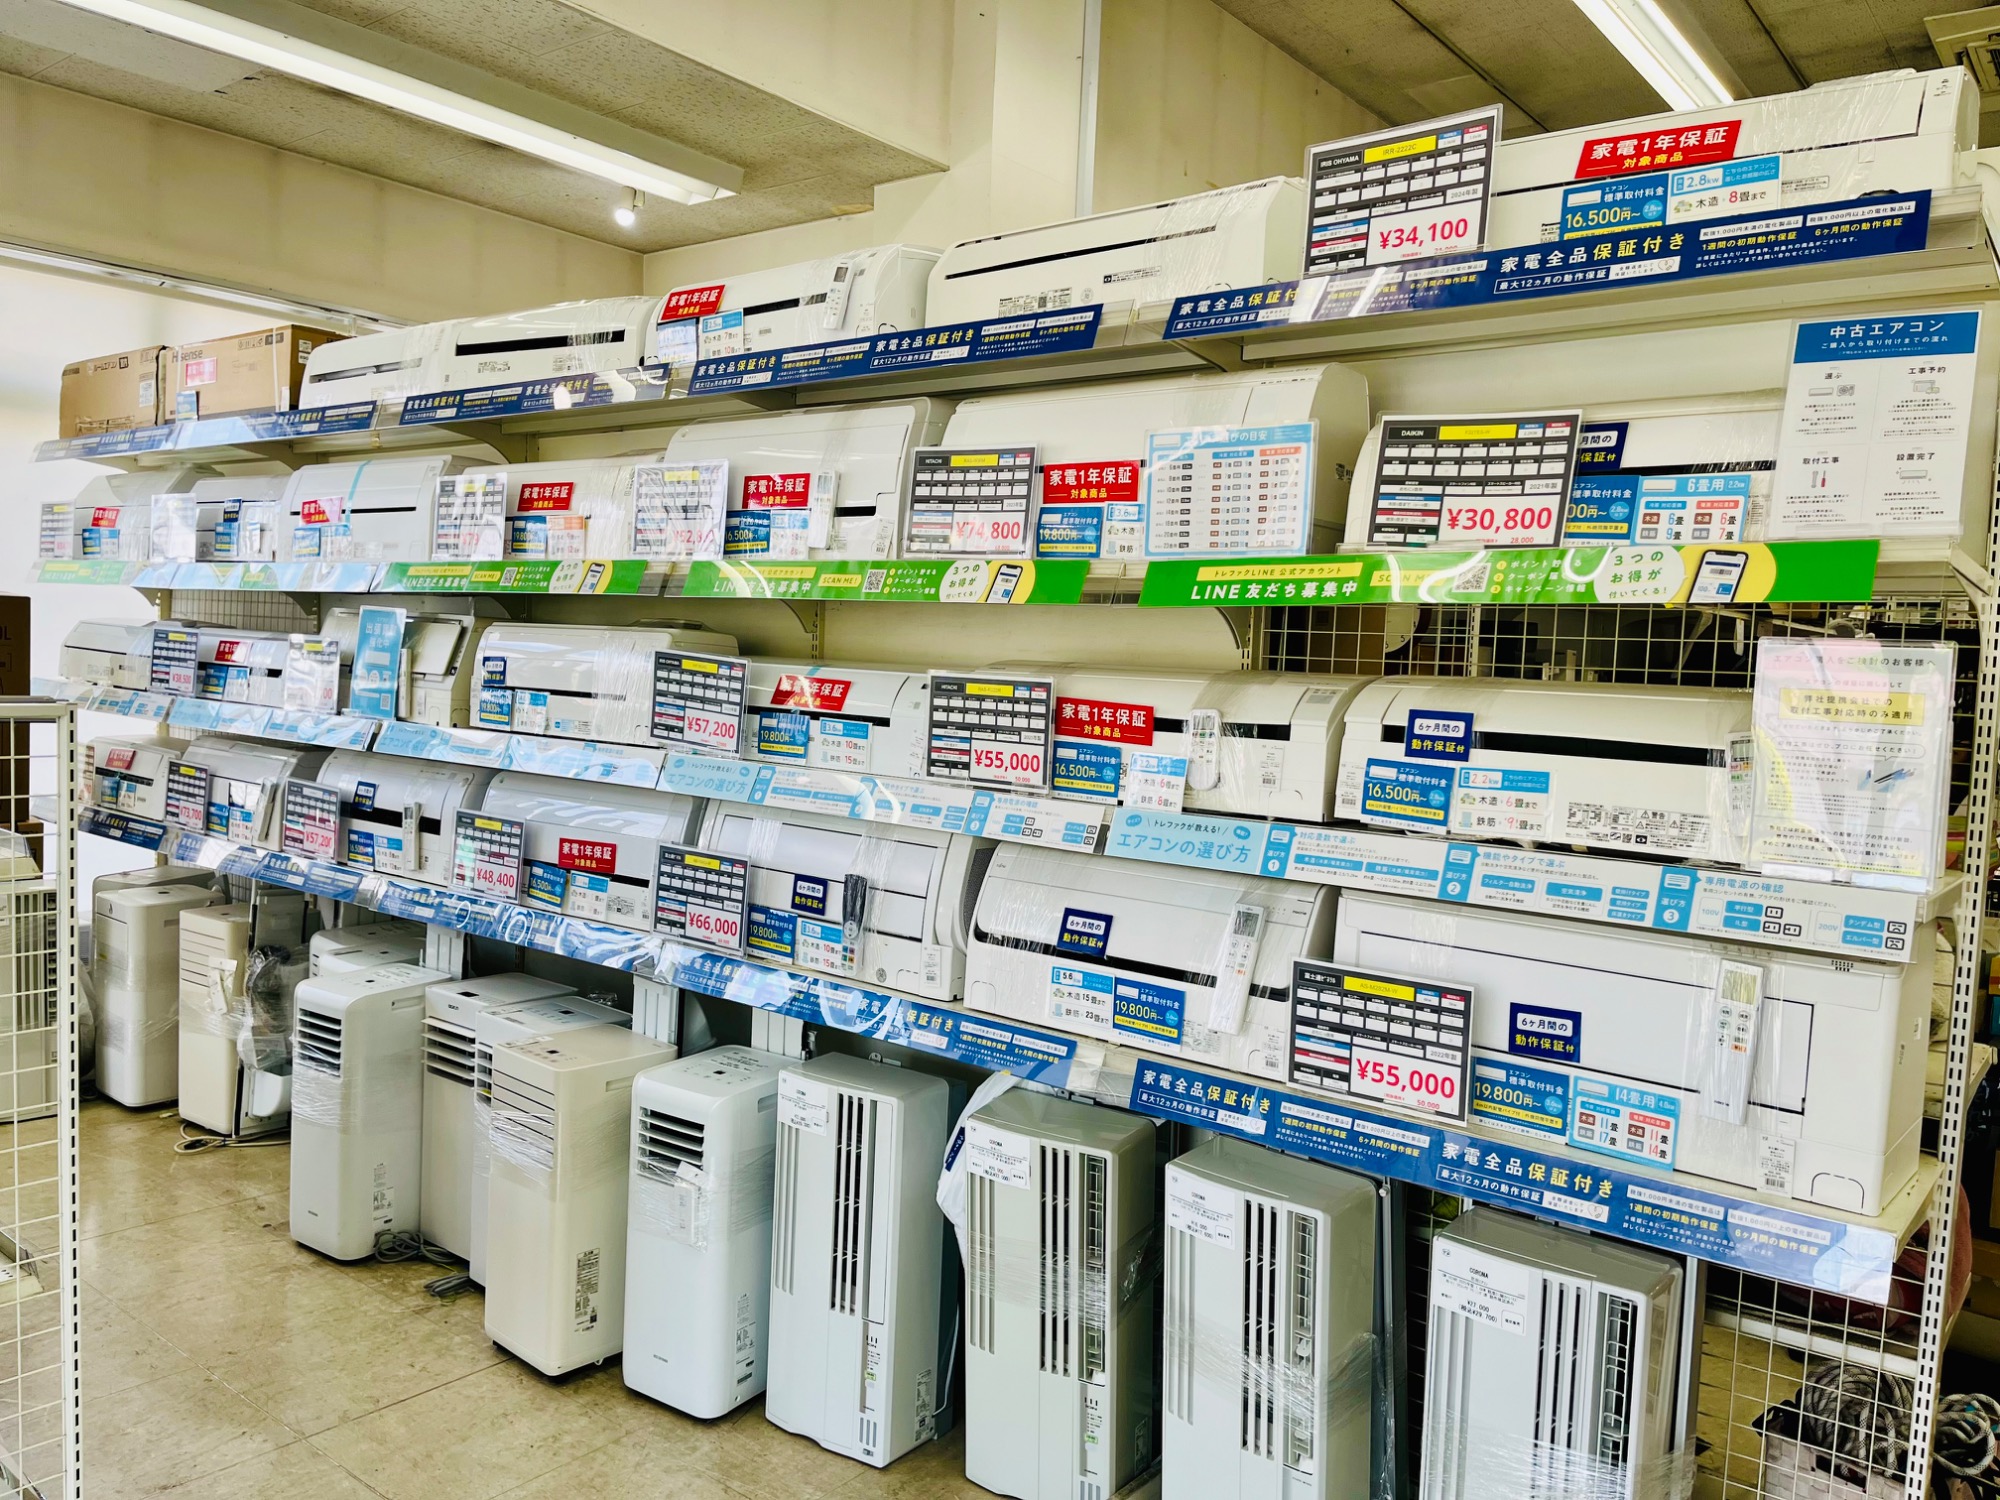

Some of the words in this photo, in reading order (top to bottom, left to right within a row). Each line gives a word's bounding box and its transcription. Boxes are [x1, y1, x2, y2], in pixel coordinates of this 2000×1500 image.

[1382, 143, 1417, 156] IRR-2222C
[1591, 125, 1730, 160] 家電1年保証
[1320, 158, 1334, 168] IRIS
[1334, 154, 1360, 166] OHYAMA
[1621, 151, 1684, 169] 対象商品
[1603, 186, 1665, 203] 標準取付料金
[1379, 217, 1469, 250] ¥34,100
[1814, 217, 1903, 237] 6ヶ月間の動作保証
[1702, 231, 1798, 252] 1週間の初期動作保証
[1500, 232, 1685, 274] 家電全品保証付き
[669, 289, 720, 308] 家電1年保証
[1829, 319, 1945, 340] 中古エアコン
[875, 328, 975, 354] 家電全品保証付き
[697, 356, 777, 377] 家電全品保証付き
[1907, 366, 1947, 375] 工事予約
[1401, 429, 1424, 437] DAIKIN
[1802, 456, 1840, 465] 取付工事
[1896, 451, 1935, 462] 設置完了
[747, 478, 806, 493] 家電1年保証
[1049, 466, 1132, 486] 家電1年保証
[1687, 478, 1725, 493] 6畳用
[522, 486, 569, 499] 家電1年保証
[1070, 488, 1108, 500] 対象商品
[1446, 507, 1553, 534] ¥30,800
[956, 521, 1021, 542] ¥74,800
[1613, 550, 1664, 567] 3つの
[1279, 565, 1343, 577] 公式アカウント
[1610, 569, 1663, 584] お得が
[1190, 583, 1241, 600] LINE
[1244, 579, 1359, 599] 友だち募集中
[1062, 703, 1147, 728] 家電1年保証
[686, 715, 736, 740] ¥57,200
[1083, 724, 1121, 739] 対象商品
[1417, 722, 1460, 734] 6ヶ月間の
[1410, 738, 1465, 754] 動作保証付
[973, 749, 1041, 773] ¥55,000
[666, 772, 749, 796] エアコンの選び方
[1398, 774, 1449, 788] 標準取付料金
[1478, 796, 1498, 806] 木造
[1153, 819, 1221, 834] トレファクが教える!
[1476, 816, 1496, 826] 鉄筋
[562, 841, 613, 860] 家電1年保証
[1116, 832, 1252, 863] エアコンの選び方
[1266, 849, 1285, 858] 選び方
[1482, 850, 1566, 869] 機能やタイプで選ぶ
[476, 869, 515, 888] ¥48,400
[1704, 875, 1785, 894] 専用電源の確認
[688, 911, 738, 937] ¥66,000
[1069, 919, 1102, 932] 6ヶ月間の
[1818, 923, 1839, 932] 200V
[1847, 918, 1881, 929] タンデム型
[1062, 932, 1104, 949] 動作保証付
[1844, 933, 1880, 945] エルバー型
[1521, 1017, 1568, 1032] 6ヶ月間の
[1514, 1034, 1575, 1054] 動作保証付
[1356, 1058, 1455, 1099] ¥55,000
[1508, 1076, 1564, 1096] 標準取付料金
[1142, 1069, 1271, 1113] 家電全品保証付き
[1615, 1087, 1656, 1109] 14畳用
[1281, 1116, 1348, 1140] 1週間の初期動作保証
[1358, 1135, 1421, 1158] 6ヶ月間の動作保証
[1442, 1141, 1614, 1199] 家電全品保証付き
[1628, 1202, 1720, 1232] 1週間の初期動作保証
[1734, 1228, 1820, 1256] 6ヶ月間の動作保証
